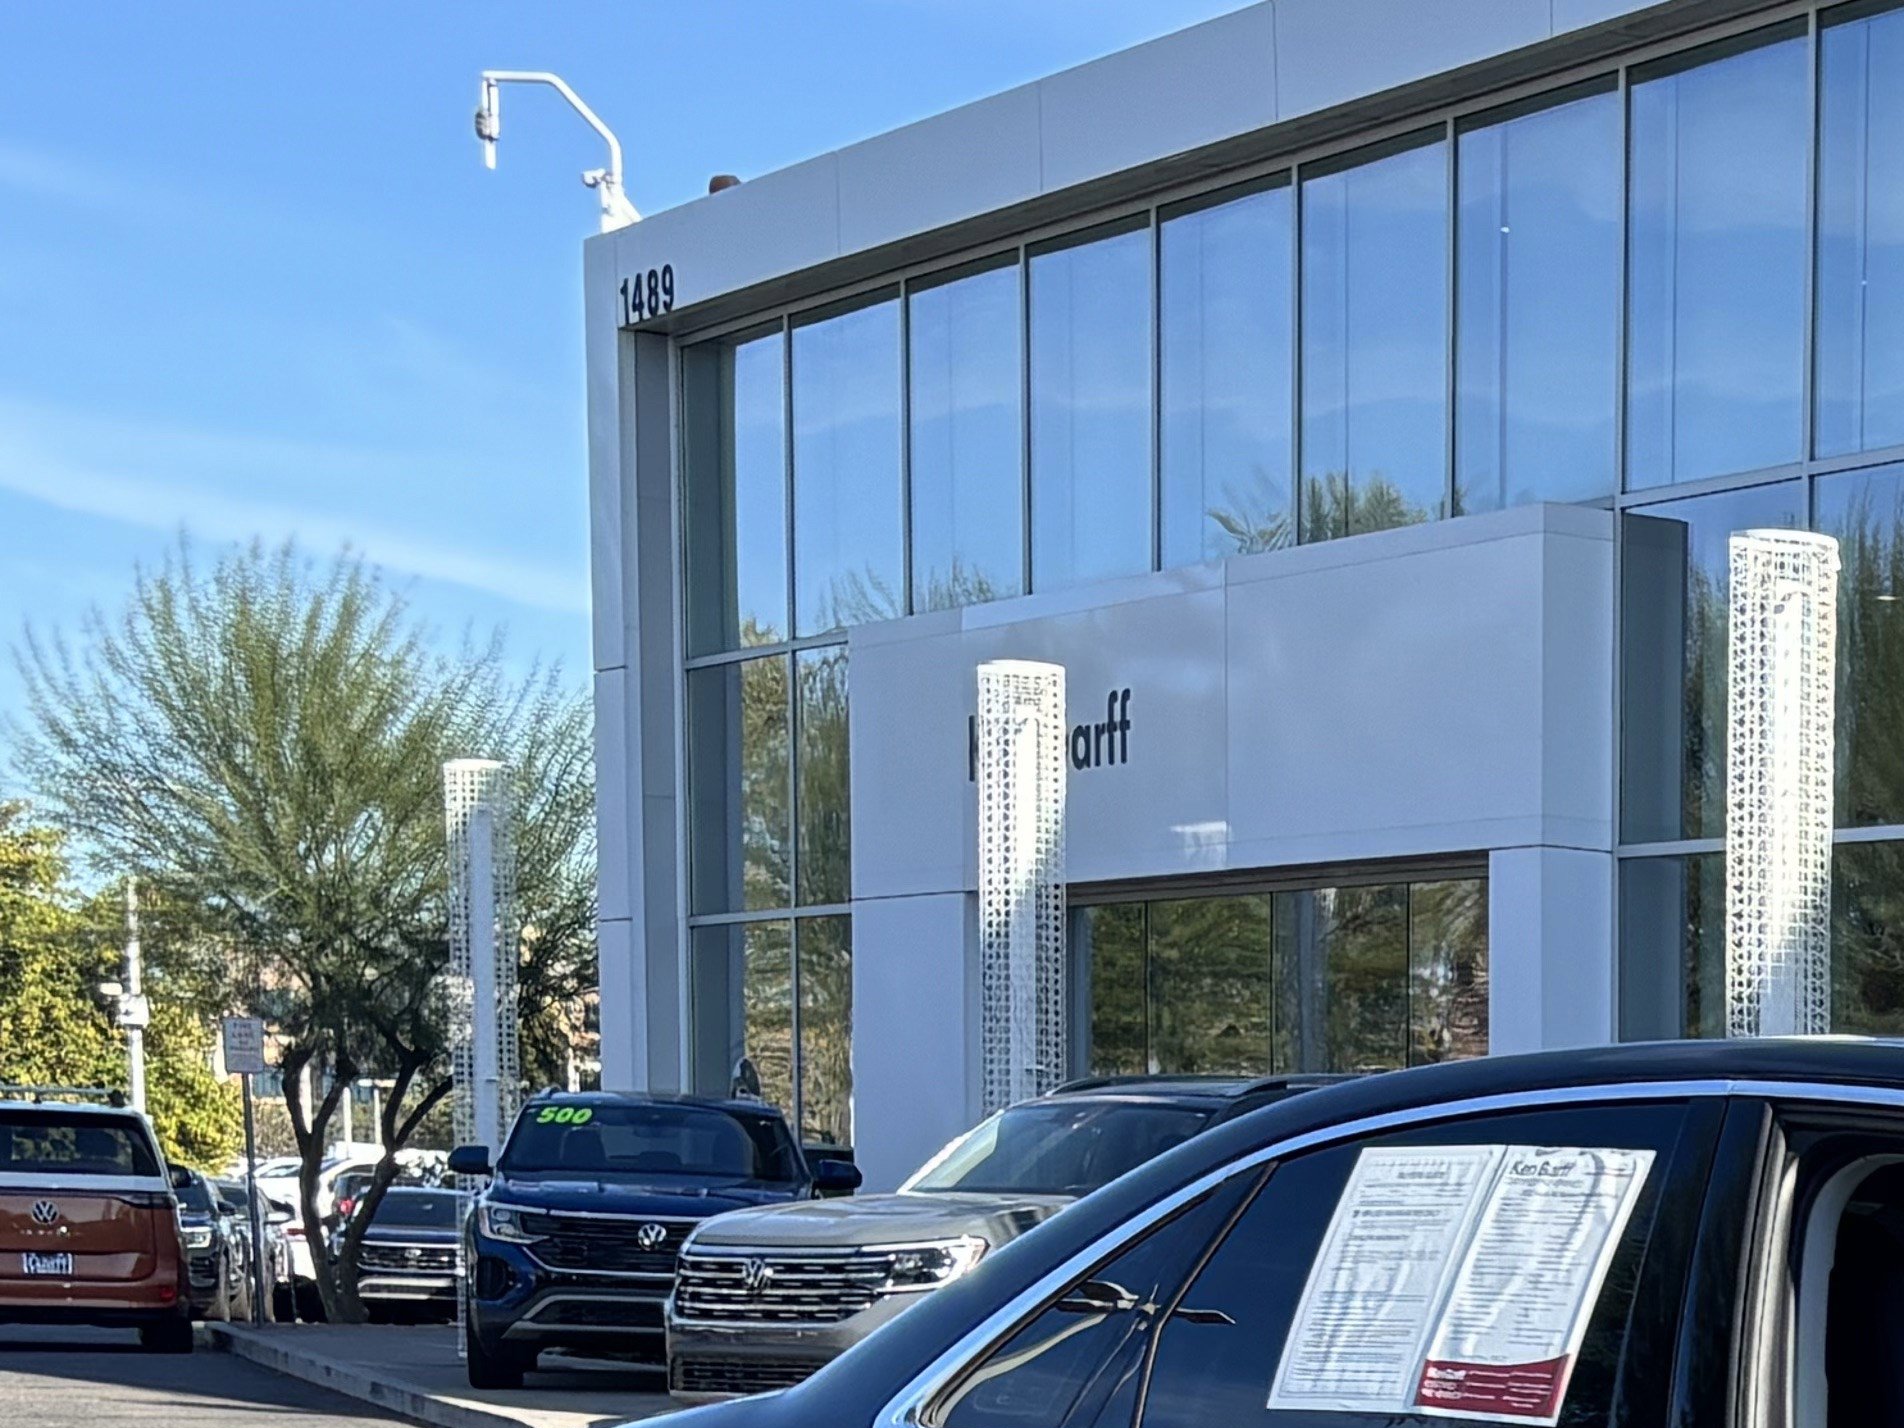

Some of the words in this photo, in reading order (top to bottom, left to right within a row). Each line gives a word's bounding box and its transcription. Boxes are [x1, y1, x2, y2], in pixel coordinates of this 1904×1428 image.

[620, 264, 674, 325] 1489
[1066, 687, 1130, 770] arff
[536, 1106, 592, 1124] 500
